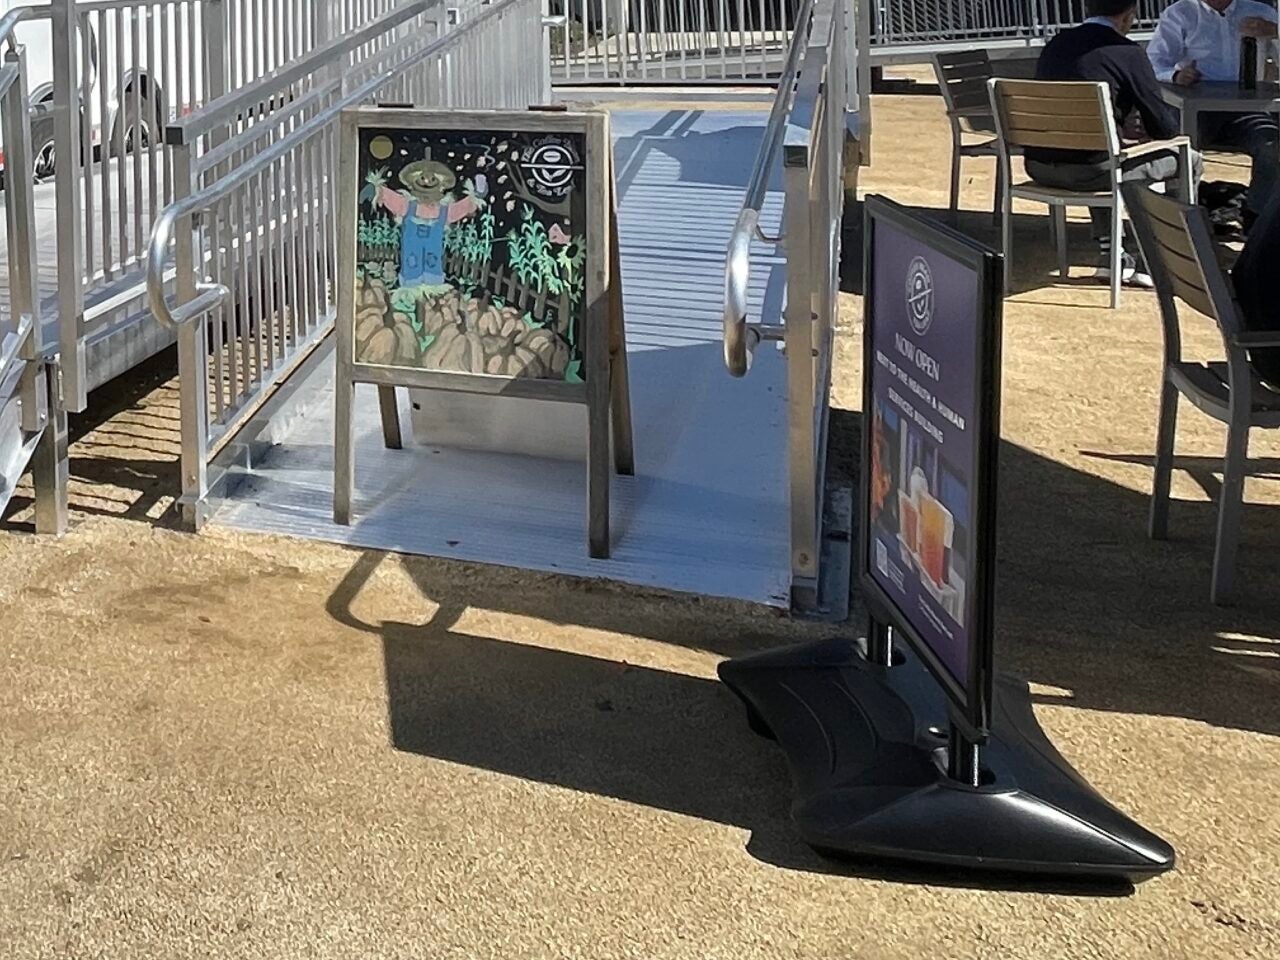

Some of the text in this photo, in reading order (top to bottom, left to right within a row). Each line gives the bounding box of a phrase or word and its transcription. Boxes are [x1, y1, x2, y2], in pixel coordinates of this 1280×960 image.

[895, 332, 940, 381] NOW OPEN
[938, 401, 965, 431] HUMAN
